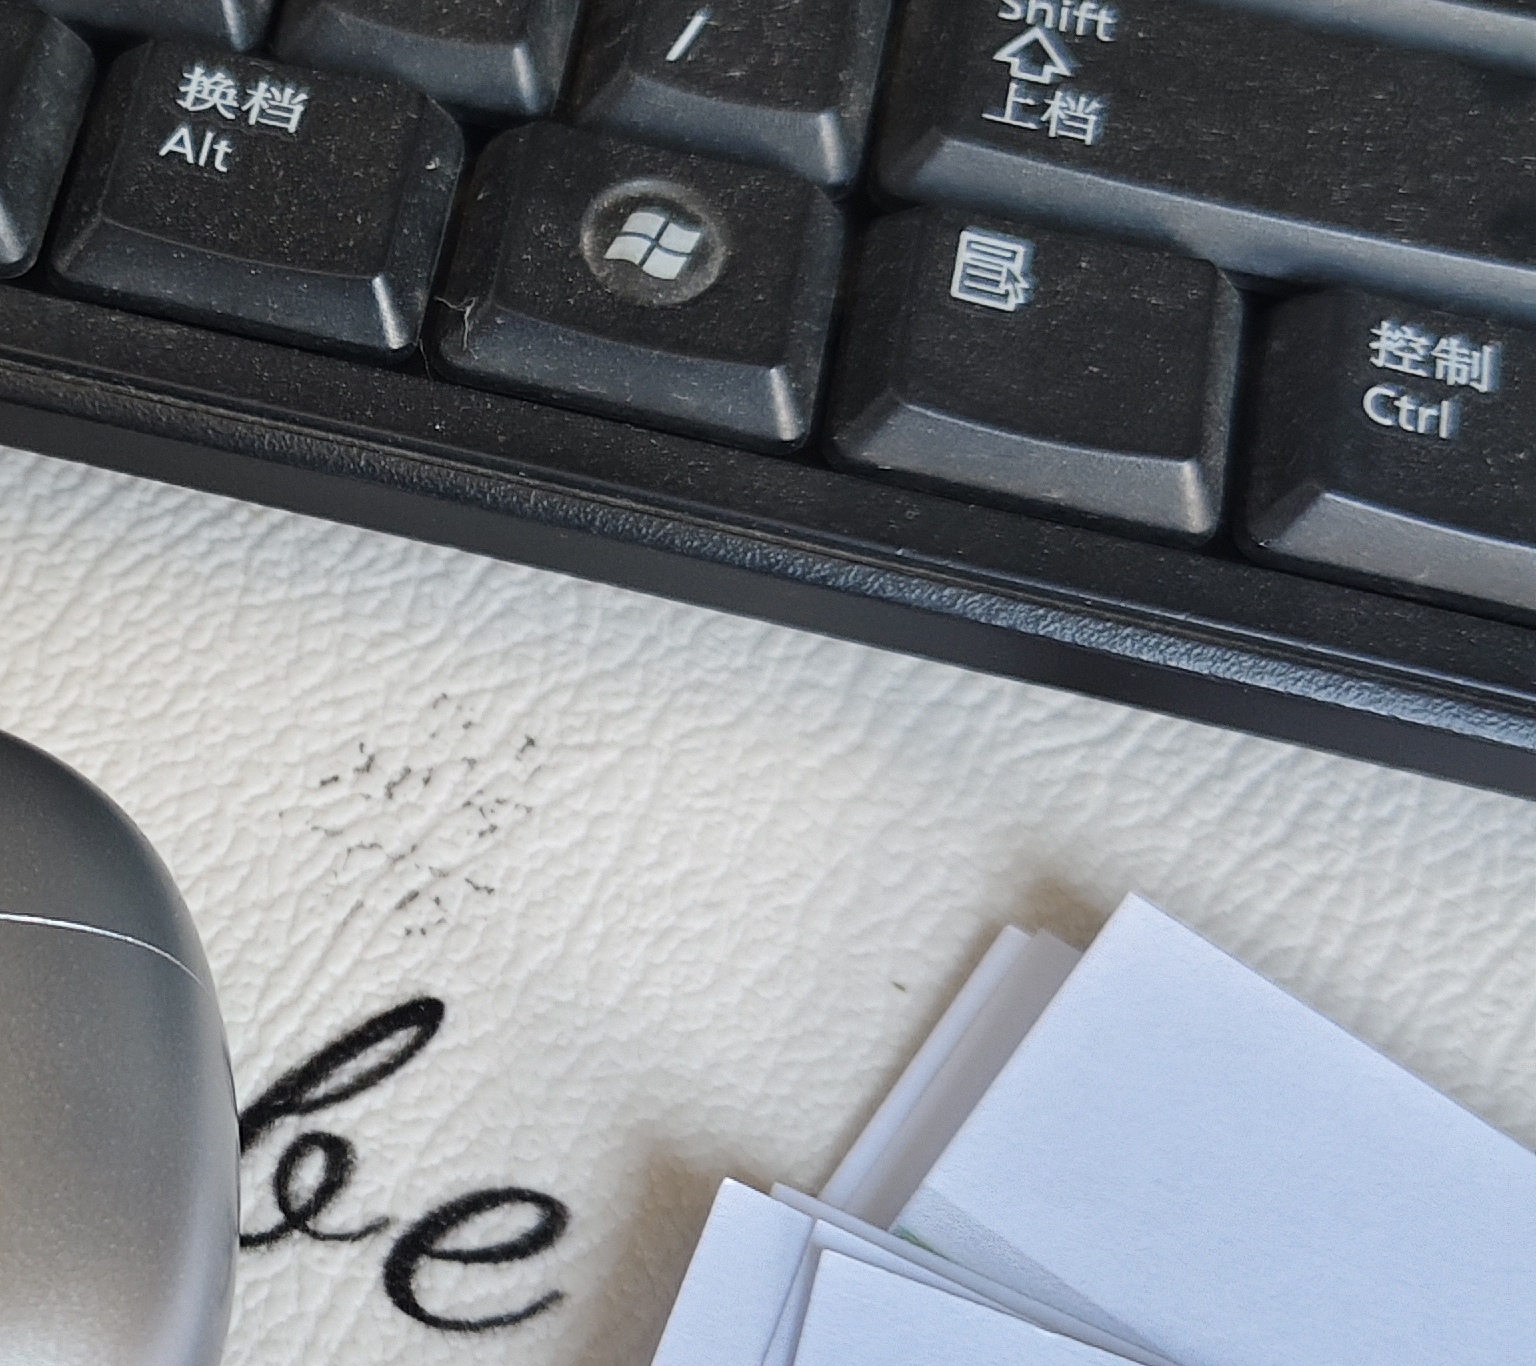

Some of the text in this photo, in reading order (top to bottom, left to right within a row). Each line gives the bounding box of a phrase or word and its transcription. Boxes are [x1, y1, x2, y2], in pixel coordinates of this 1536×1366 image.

[665, 10, 709, 62] /
[175, 64, 309, 134] 换档
[981, 83, 1105, 145] 上档
[158, 124, 233, 173] Alt
[1368, 320, 1499, 393] 控制
[1362, 386, 1457, 439] Ctrl
